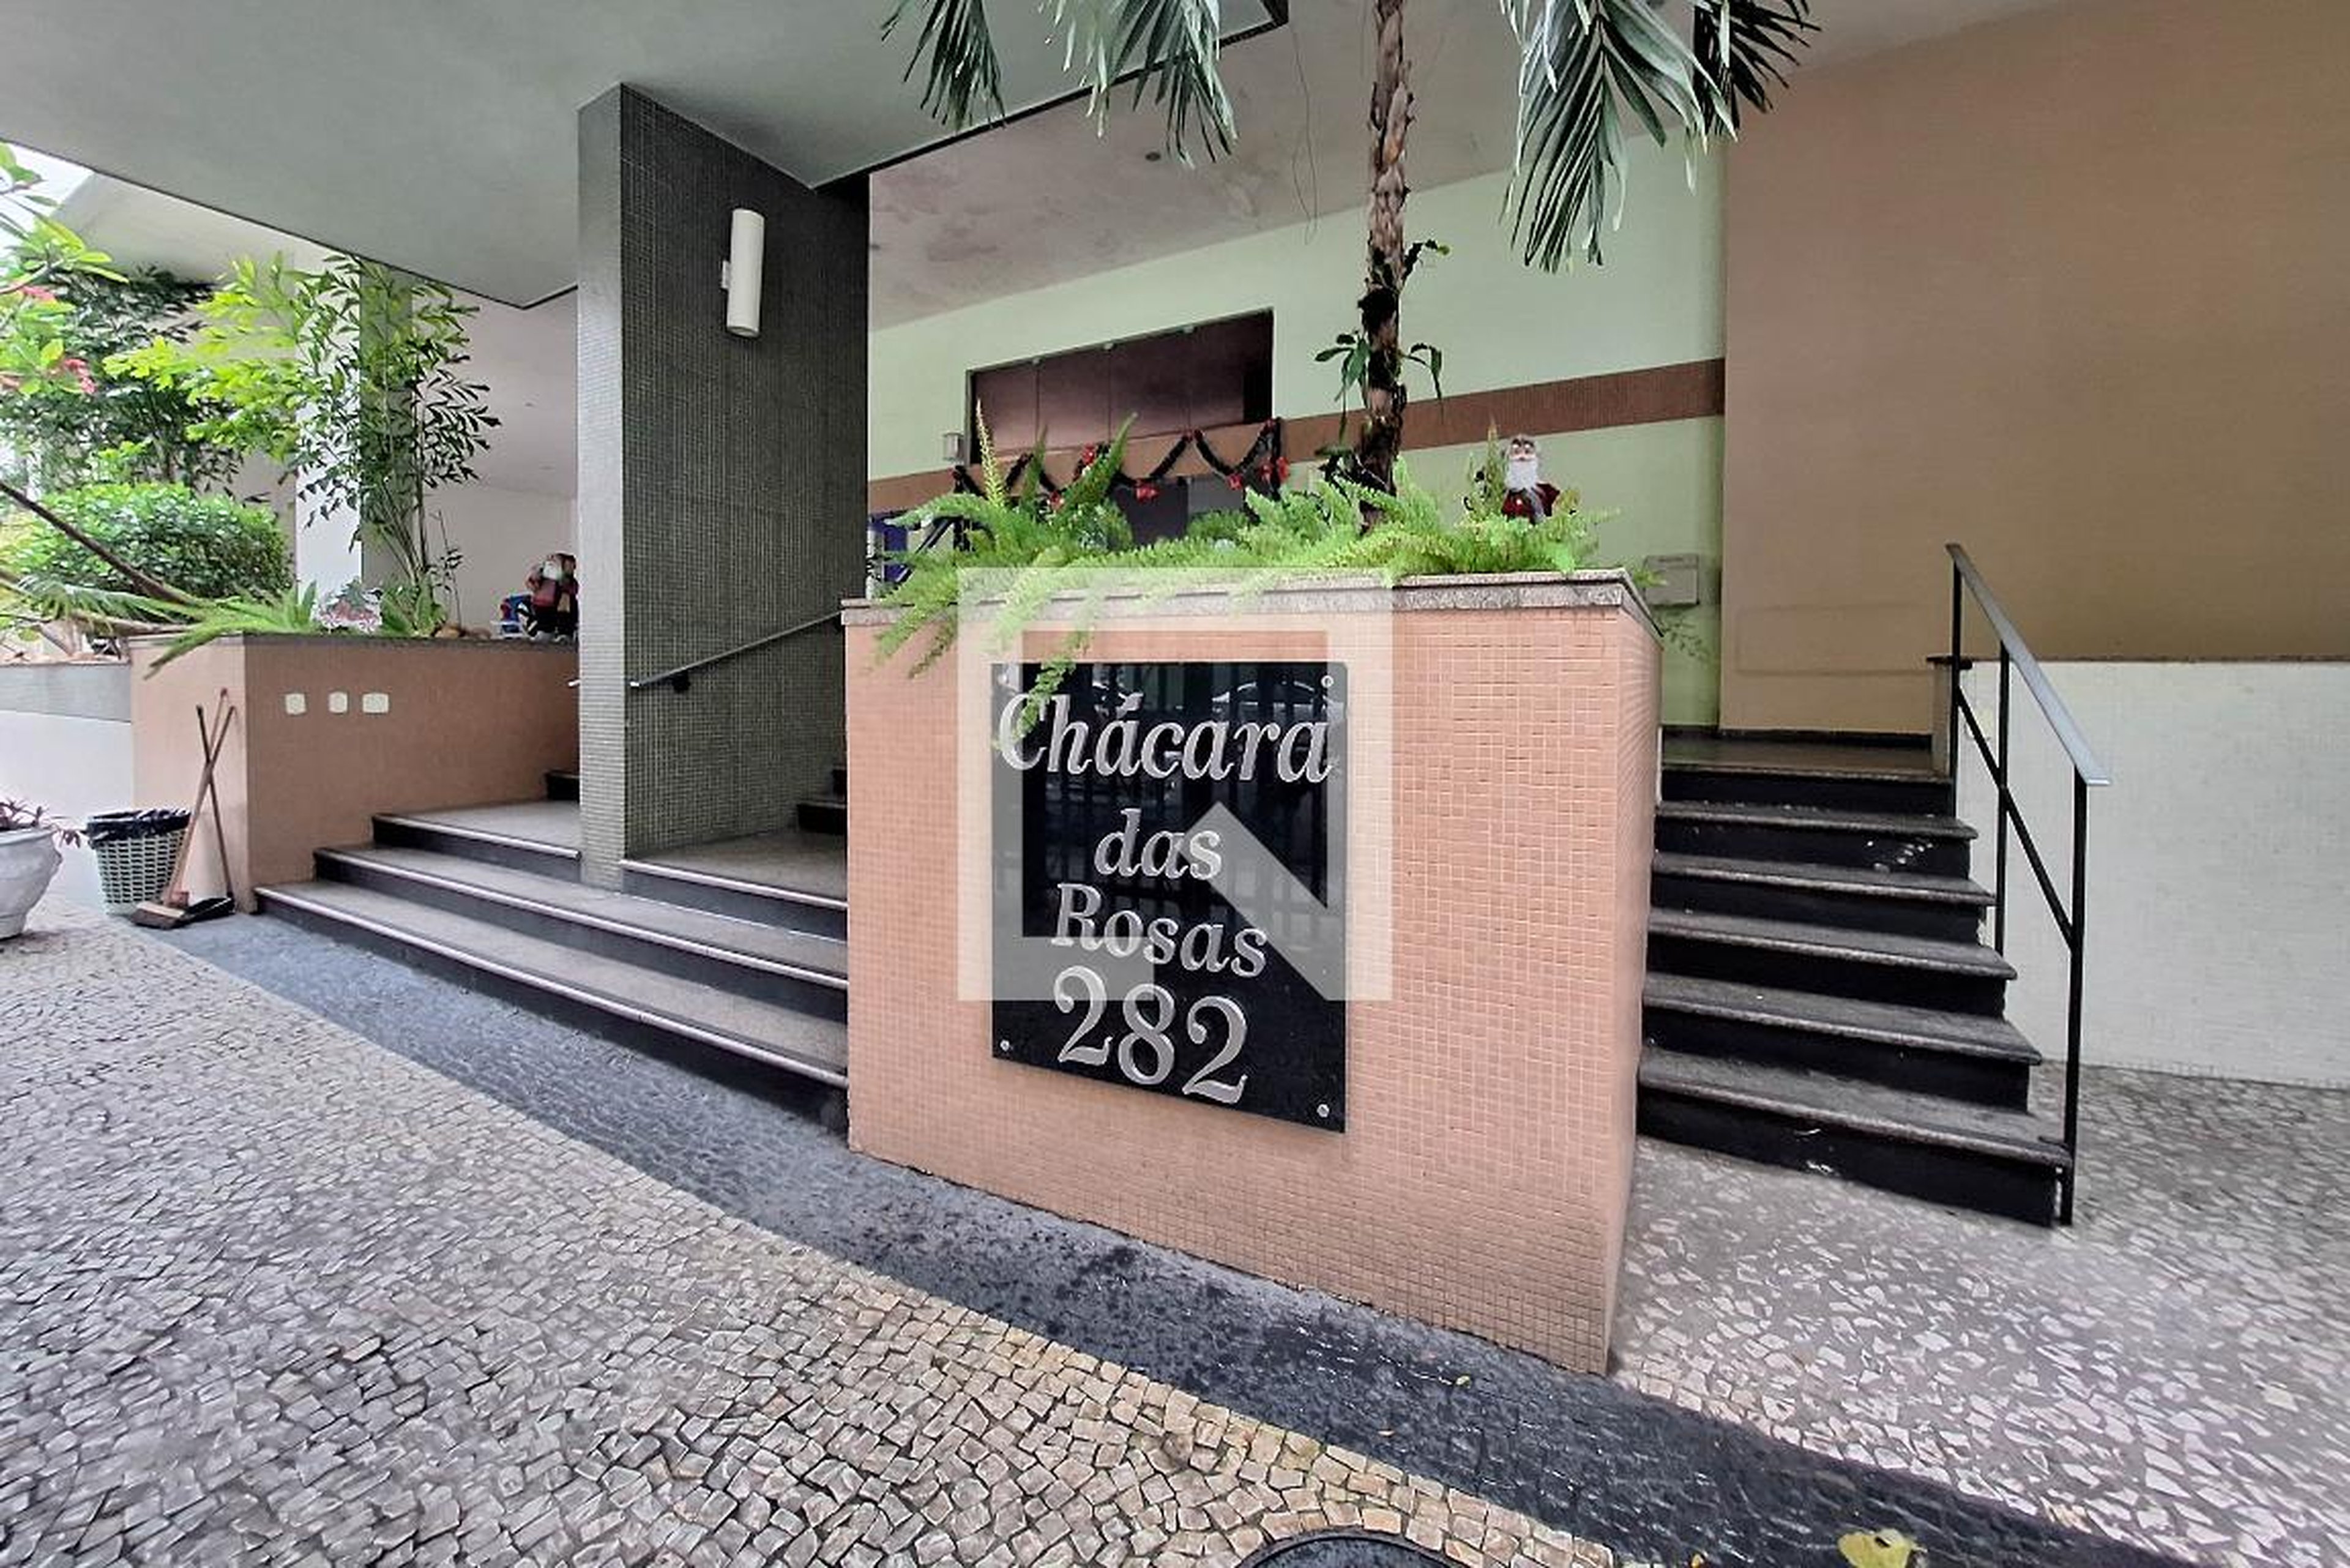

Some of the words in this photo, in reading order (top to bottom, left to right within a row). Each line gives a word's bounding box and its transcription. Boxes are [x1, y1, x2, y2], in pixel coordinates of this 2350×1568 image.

[998, 692, 1335, 783] Chácara
[1095, 808, 1223, 880] das
[1051, 883, 1267, 977] Rosas
[1054, 965, 1247, 1103] 282
